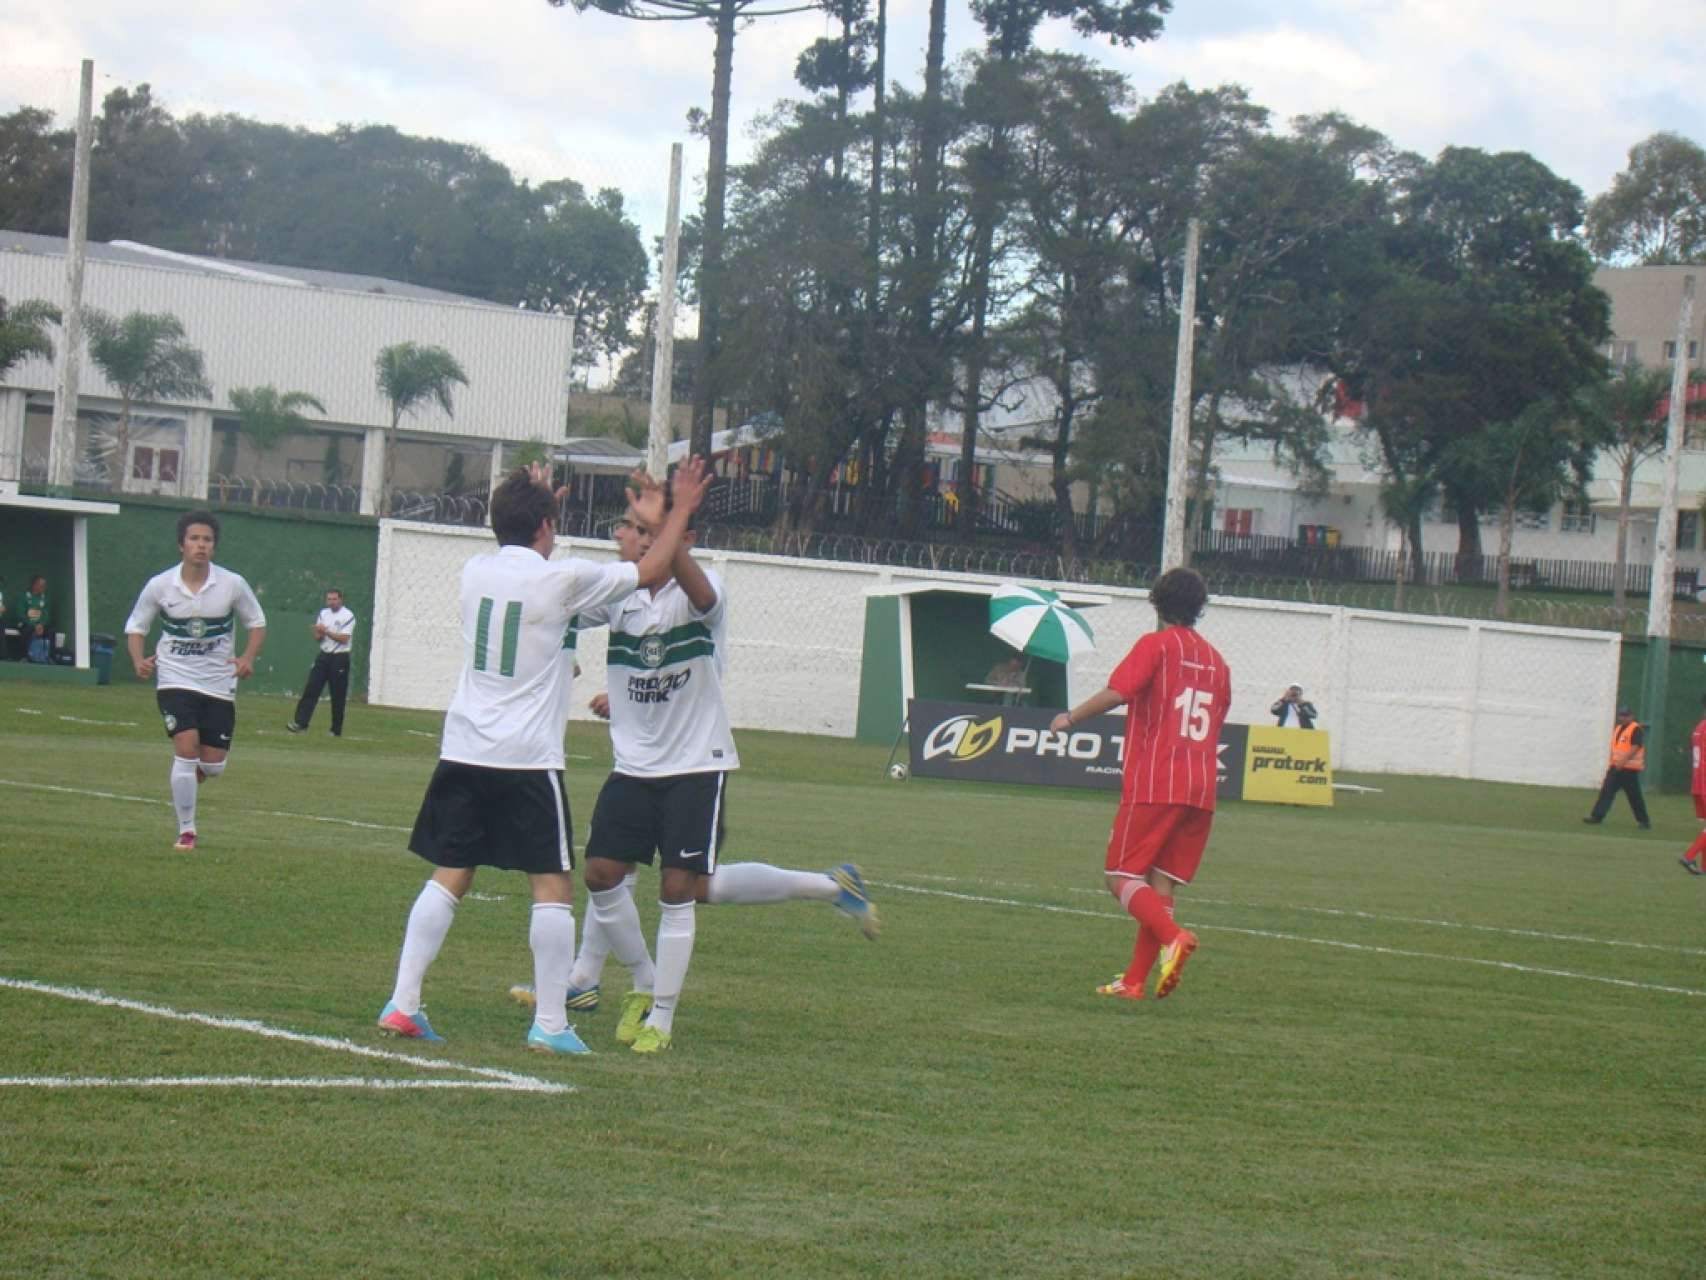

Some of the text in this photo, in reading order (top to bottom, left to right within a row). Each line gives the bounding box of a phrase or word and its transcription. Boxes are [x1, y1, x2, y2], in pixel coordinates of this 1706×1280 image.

[473, 596, 522, 677] 11
[628, 688, 669, 703] TORK
[1174, 686, 1214, 741] 15
[1006, 727, 1101, 759] PRO
[1252, 756, 1326, 772] protork
[1296, 775, 1327, 785] .com
